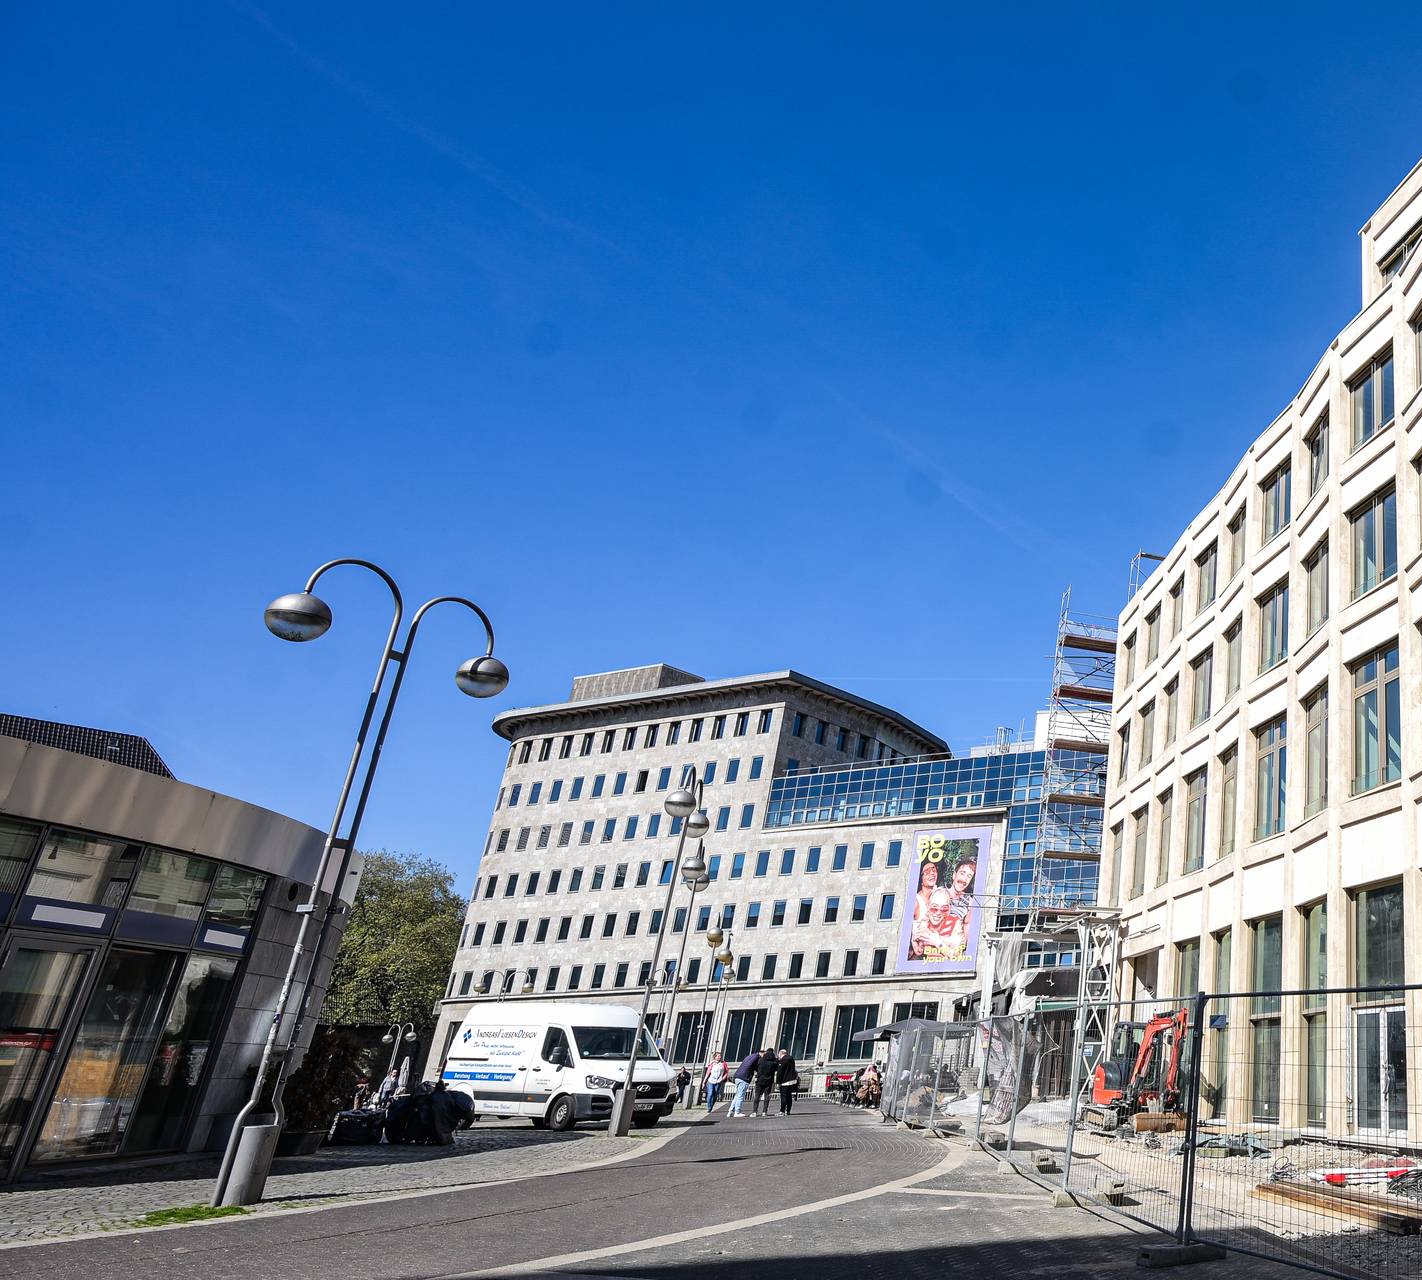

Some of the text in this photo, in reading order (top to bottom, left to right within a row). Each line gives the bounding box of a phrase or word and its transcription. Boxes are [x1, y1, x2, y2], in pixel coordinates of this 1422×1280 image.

[917, 833, 945, 849] BO
[922, 955, 945, 966] your
[453, 1072, 471, 1080] Beratung
